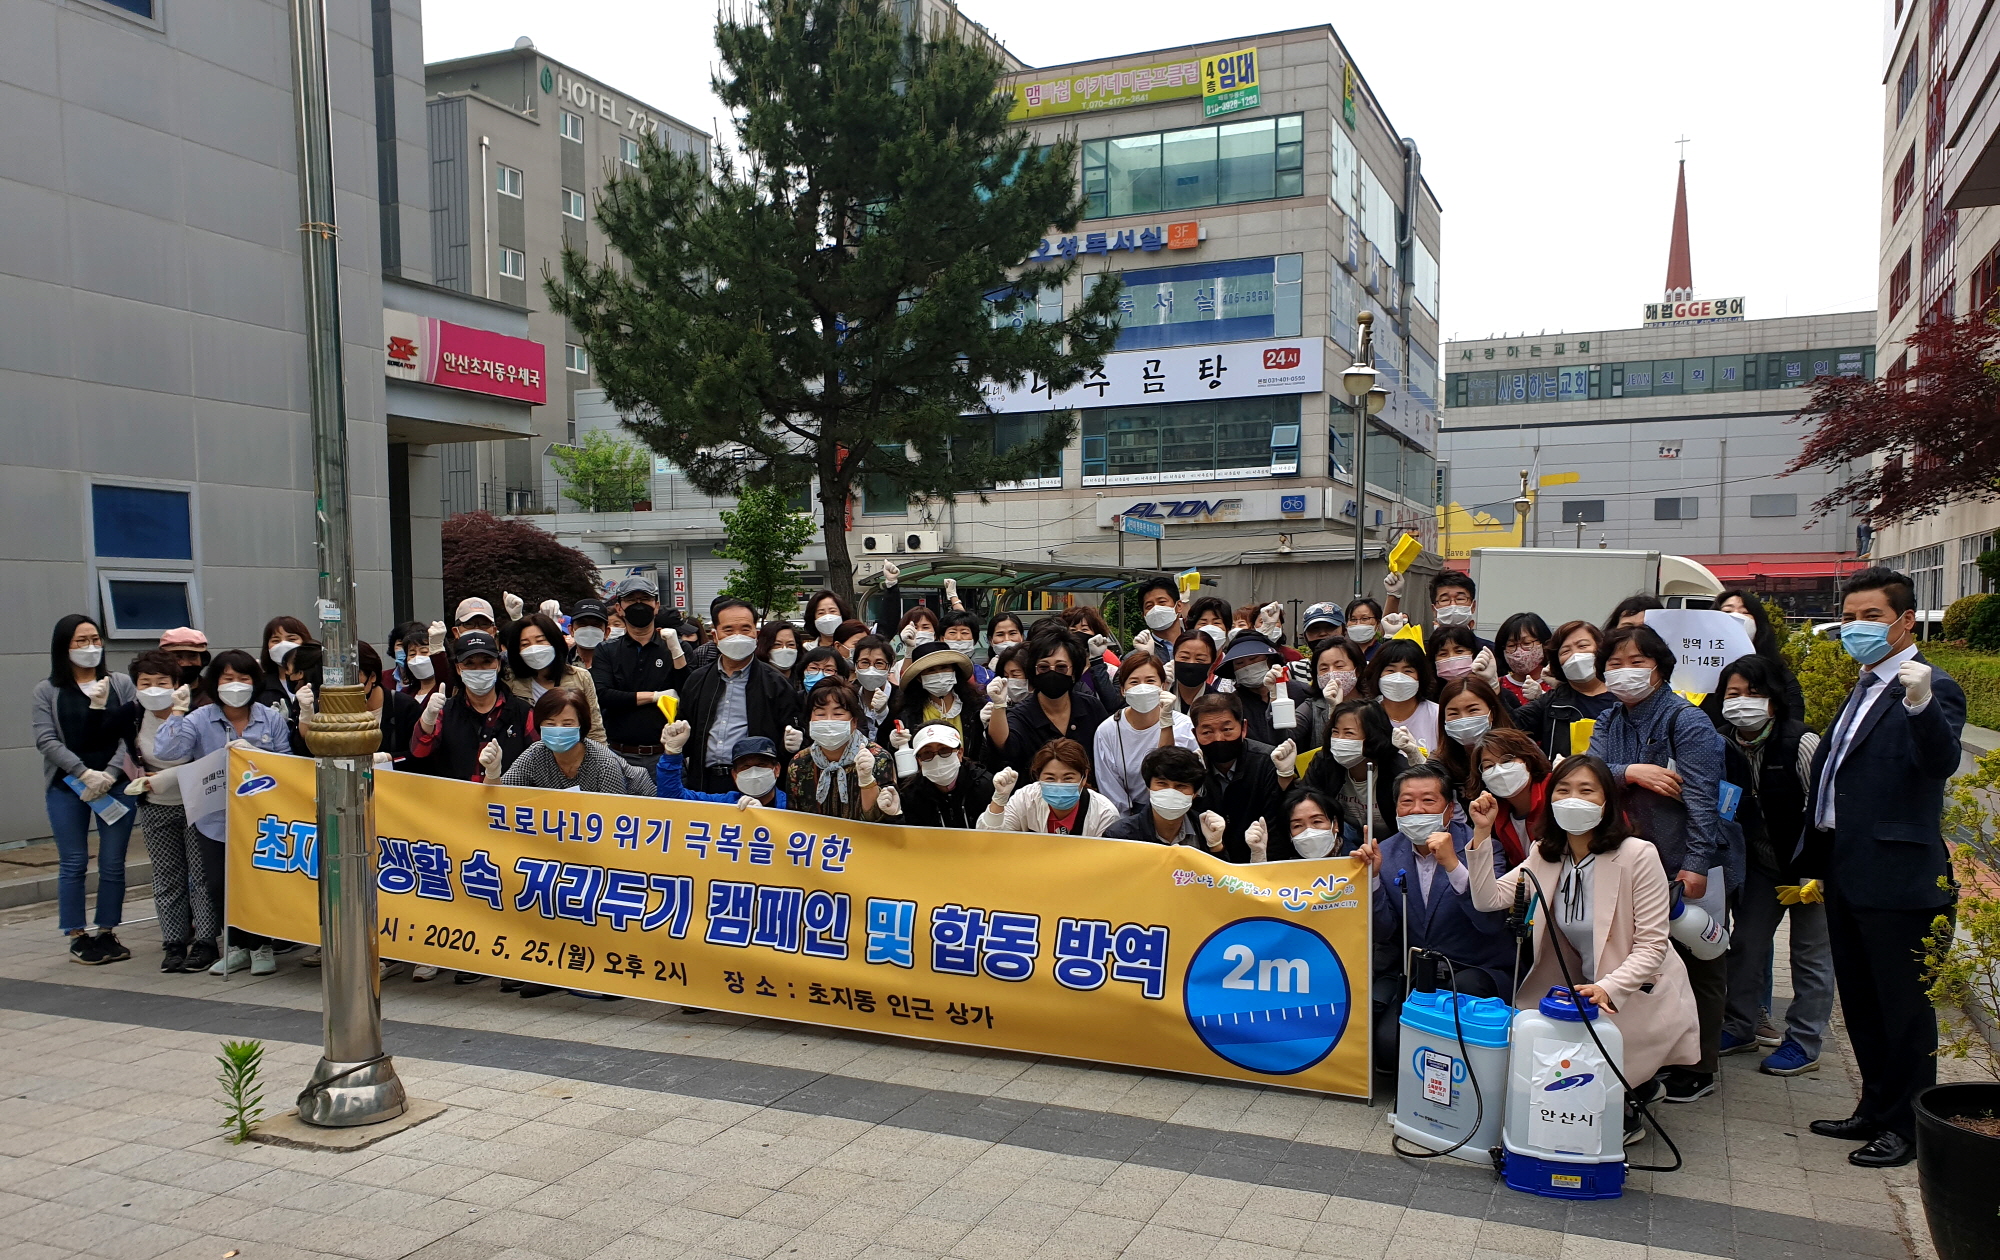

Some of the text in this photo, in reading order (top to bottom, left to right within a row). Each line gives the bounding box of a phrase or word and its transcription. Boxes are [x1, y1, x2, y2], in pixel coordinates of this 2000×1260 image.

[1074, 61, 1200, 99] 아카데미골프클럽
[1217, 52, 1255, 89] 임대
[558, 74, 658, 136] HOTEL 727
[1174, 225, 1189, 238] 3F
[387, 359, 416, 370] KOREA POST
[443, 351, 540, 388] 안산초지동우체국
[1266, 351, 1297, 366] 24시
[1121, 498, 1243, 519] ALTON
[675, 567, 684, 607] 주차금
[1682, 638, 1724, 649] 방역 1조
[487, 802, 852, 873] 코로나19 위기 극복을 위한
[252, 814, 1170, 1000] 초지 생활 속 거리두기 캠페인 및 합동 방역
[1311, 900, 1358, 910] ANSAN CITY
[424, 924, 480, 954] 2020.
[491, 935, 511, 960] 5.
[521, 939, 595, 973] 25.(월)
[603, 951, 645, 979] 오후
[653, 959, 688, 986] 2시
[1222, 944, 1310, 993] 2m
[808, 981, 876, 1013] 초지동
[886, 993, 934, 1020] 인근
[945, 1001, 994, 1029] 상가
[1540, 1109, 1593, 1127] 안산시
